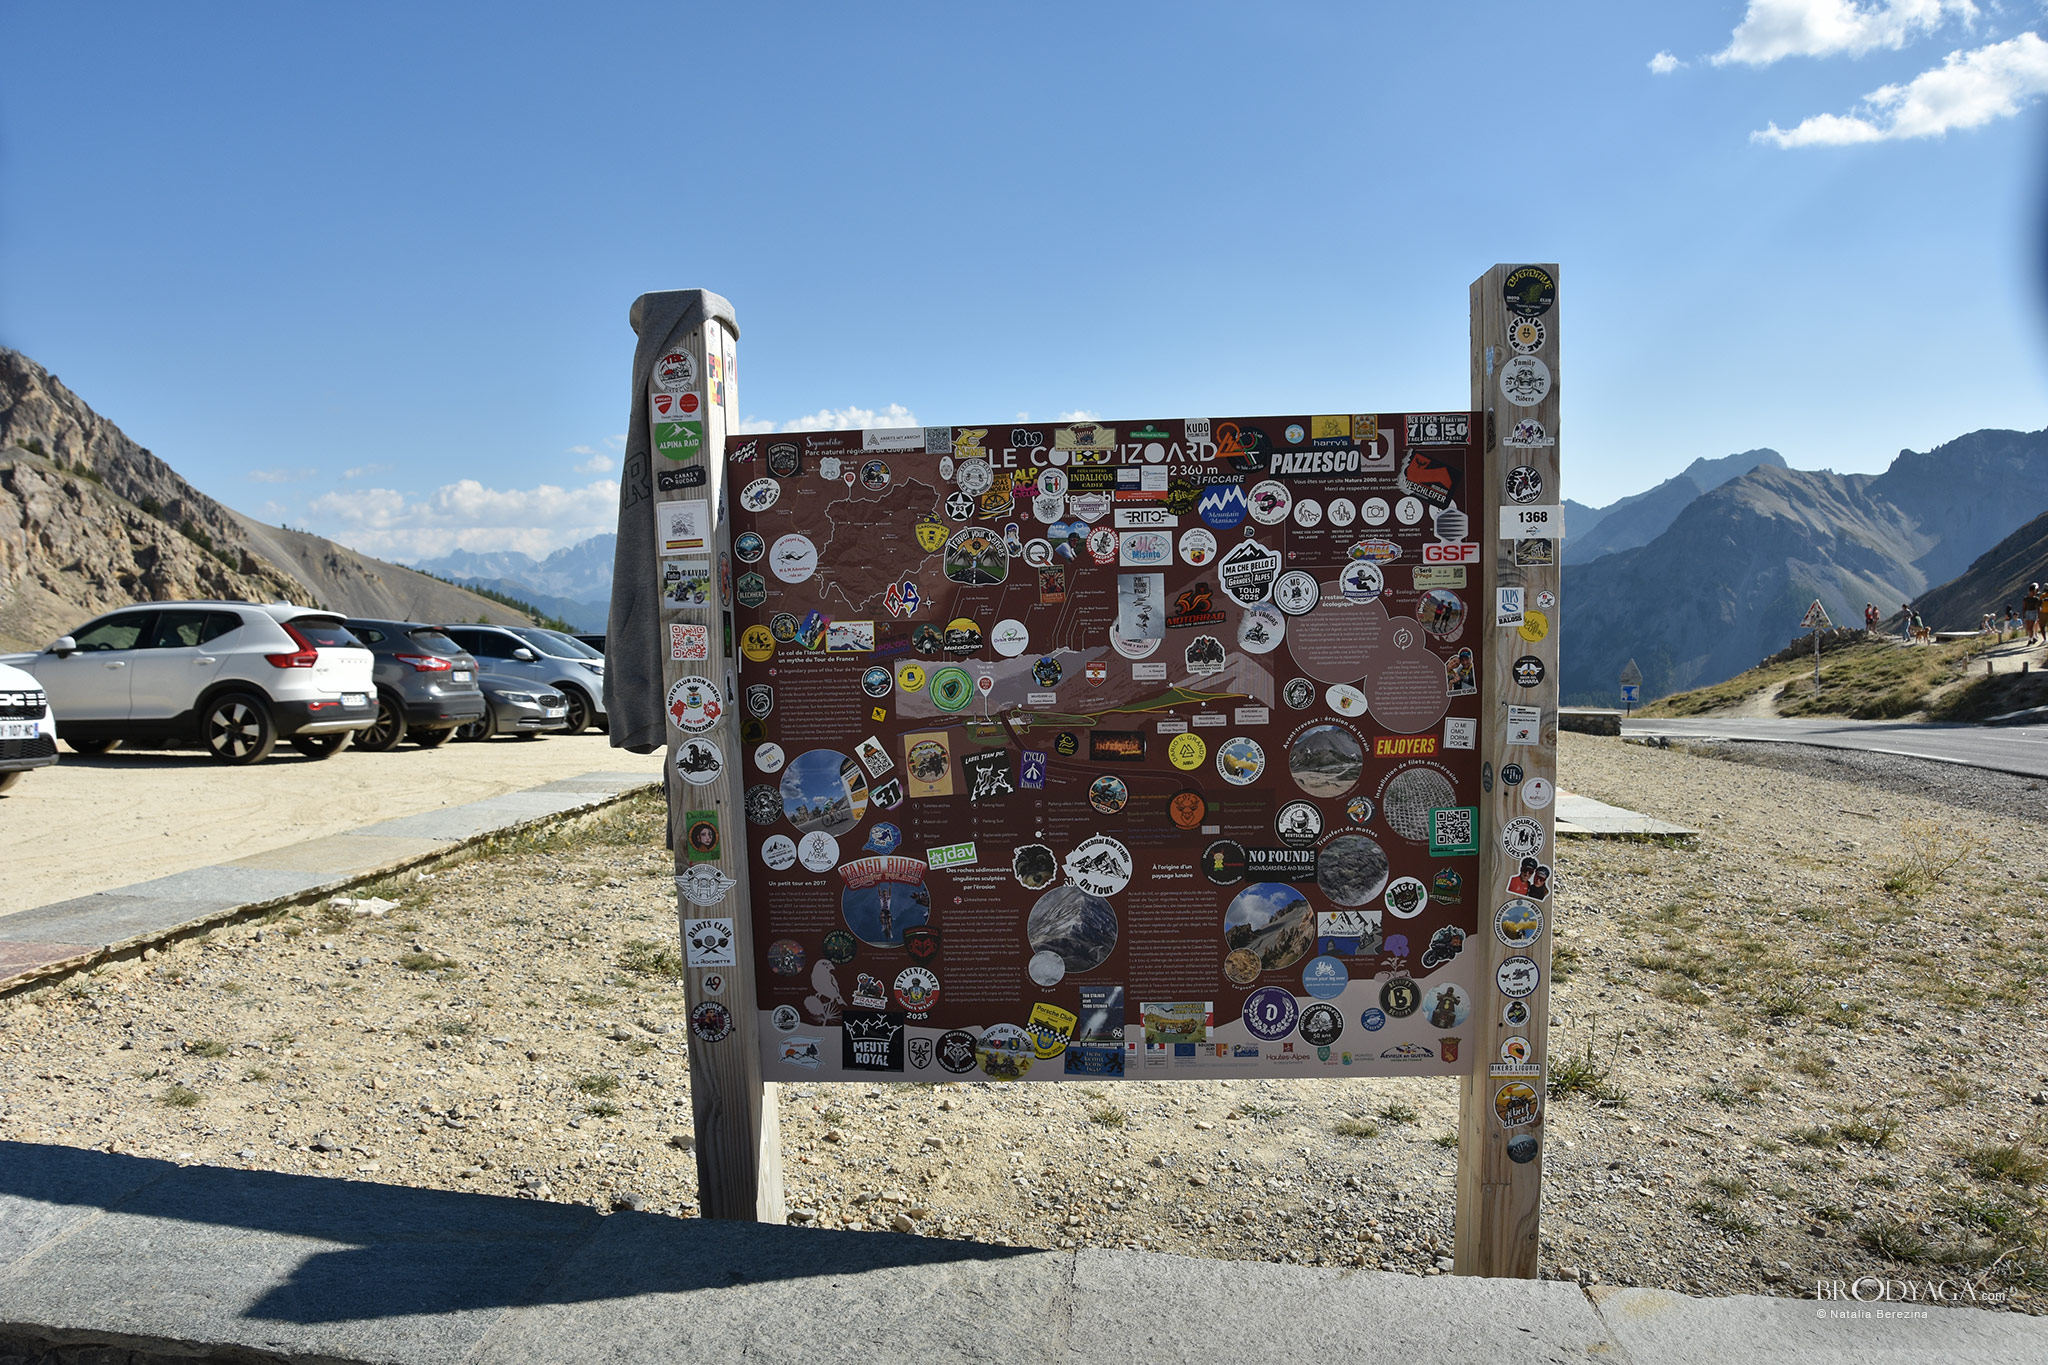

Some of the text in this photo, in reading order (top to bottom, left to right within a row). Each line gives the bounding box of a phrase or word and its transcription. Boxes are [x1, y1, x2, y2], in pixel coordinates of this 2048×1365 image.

[1186, 423, 1209, 433] KUDO
[1408, 423, 1468, 437] 7 6 50
[660, 439, 699, 449] ALPINA RAID
[989, 448, 1018, 468] LE
[1269, 450, 1359, 474] PAZZESCO
[1170, 465, 1177, 475] 2
[1180, 465, 1203, 475] 360
[1070, 473, 1113, 482] INDALICOS
[1202, 475, 1245, 484] FICCARE
[1518, 511, 1548, 523] 1368
[971, 530, 985, 540] your
[1425, 545, 1477, 561] GSF
[1225, 561, 1268, 573] MA CHE BELLO
[1254, 573, 1271, 582] ALPES
[1502, 589, 1518, 603] INPS
[1167, 612, 1225, 626] MOTORRAD
[1250, 610, 1258, 618] DE
[668, 689, 678, 707] MOTO
[675, 679, 692, 690] CLUB
[706, 681, 720, 702] BOSCO
[680, 720, 715, 733] ARENZANO
[1325, 716, 1370, 752] érosion du terrain
[1376, 738, 1435, 755] ENJOYERS
[965, 756, 980, 764] LABEL
[1024, 752, 1045, 763] CYCLO
[876, 782, 901, 809] 31
[1317, 827, 1344, 846] Transfert
[1355, 826, 1379, 838] mottes
[942, 843, 974, 860] jdav
[1249, 850, 1310, 863] NO FOUND
[842, 858, 923, 880] TANGO RIDER
[1079, 879, 1113, 895] On Tour
[1394, 883, 1414, 894] MGO
[688, 920, 732, 939] DARTS CLUB
[906, 1012, 928, 1020] 2025
[1037, 1005, 1073, 1022] Porsche Club
[1304, 1006, 1315, 1018] CLUB
[1321, 1005, 1332, 1013] PAYS
[1112, 1029, 1122, 1038] 96
[853, 1042, 890, 1053] MEUTE
[855, 1053, 889, 1066] ROYAL
